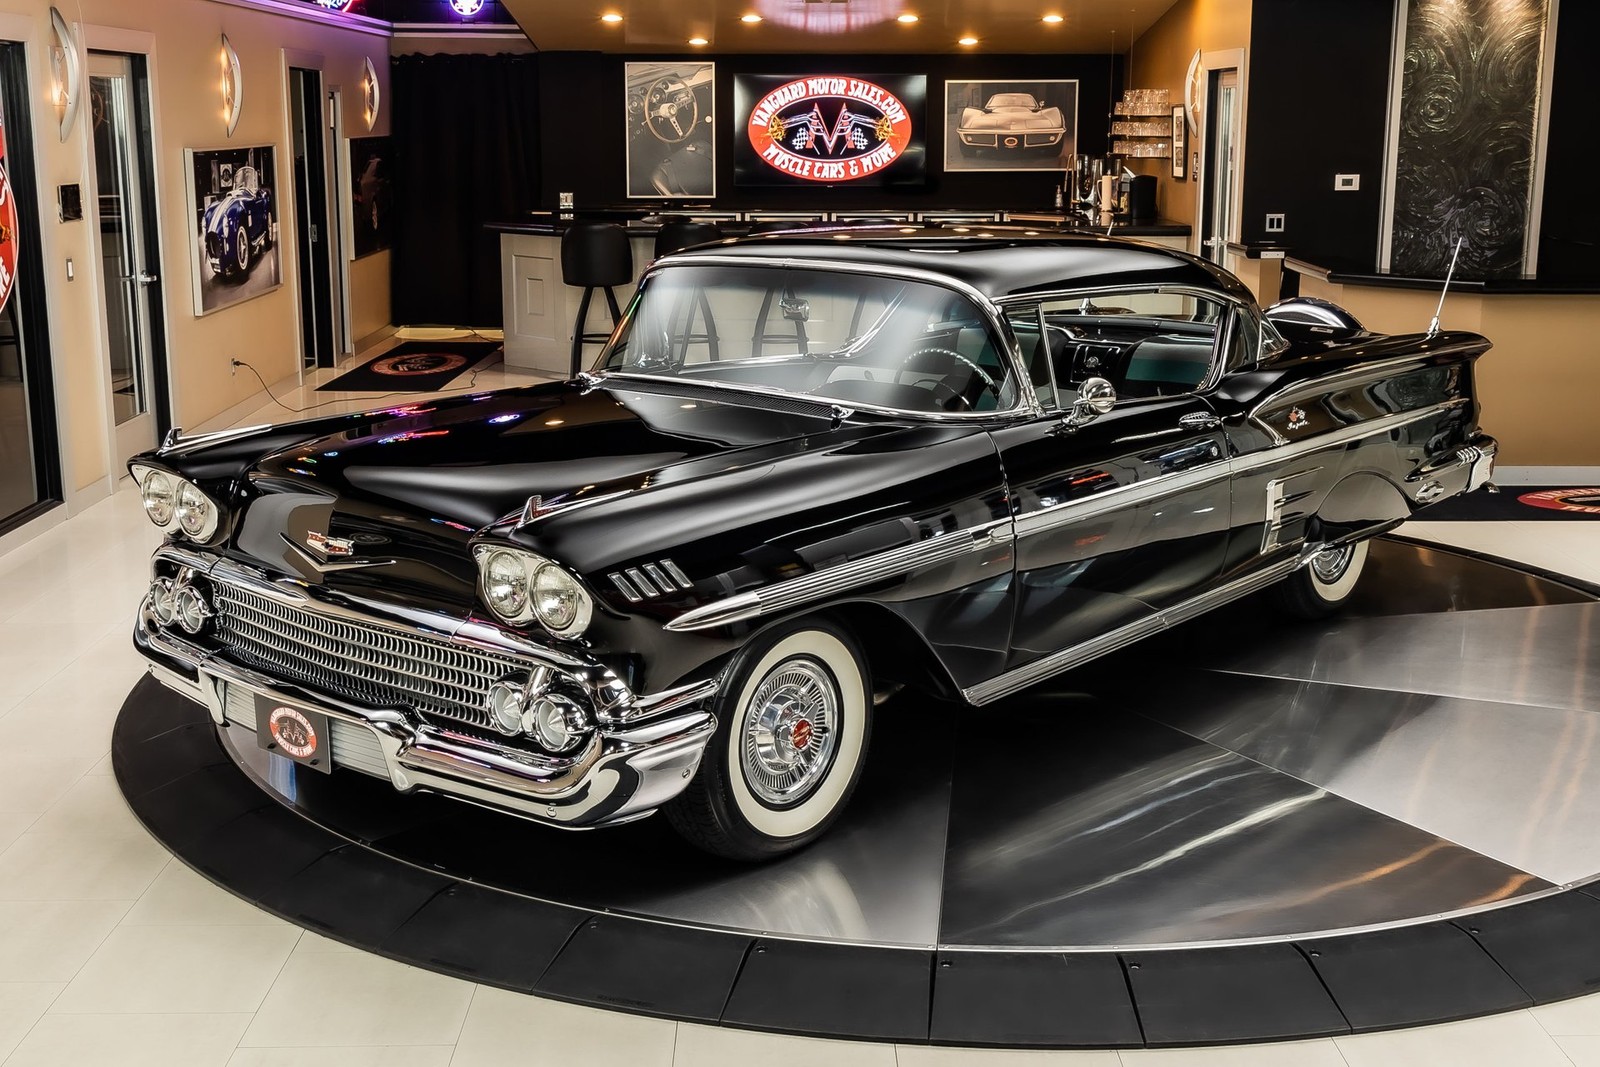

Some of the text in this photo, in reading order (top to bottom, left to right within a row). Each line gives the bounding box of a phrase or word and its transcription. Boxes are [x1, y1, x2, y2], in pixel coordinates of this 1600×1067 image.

[752, 78, 907, 127] VANGUARD MOTOR SALES.COM
[762, 143, 898, 179] MUSCLE CARS & MORE
